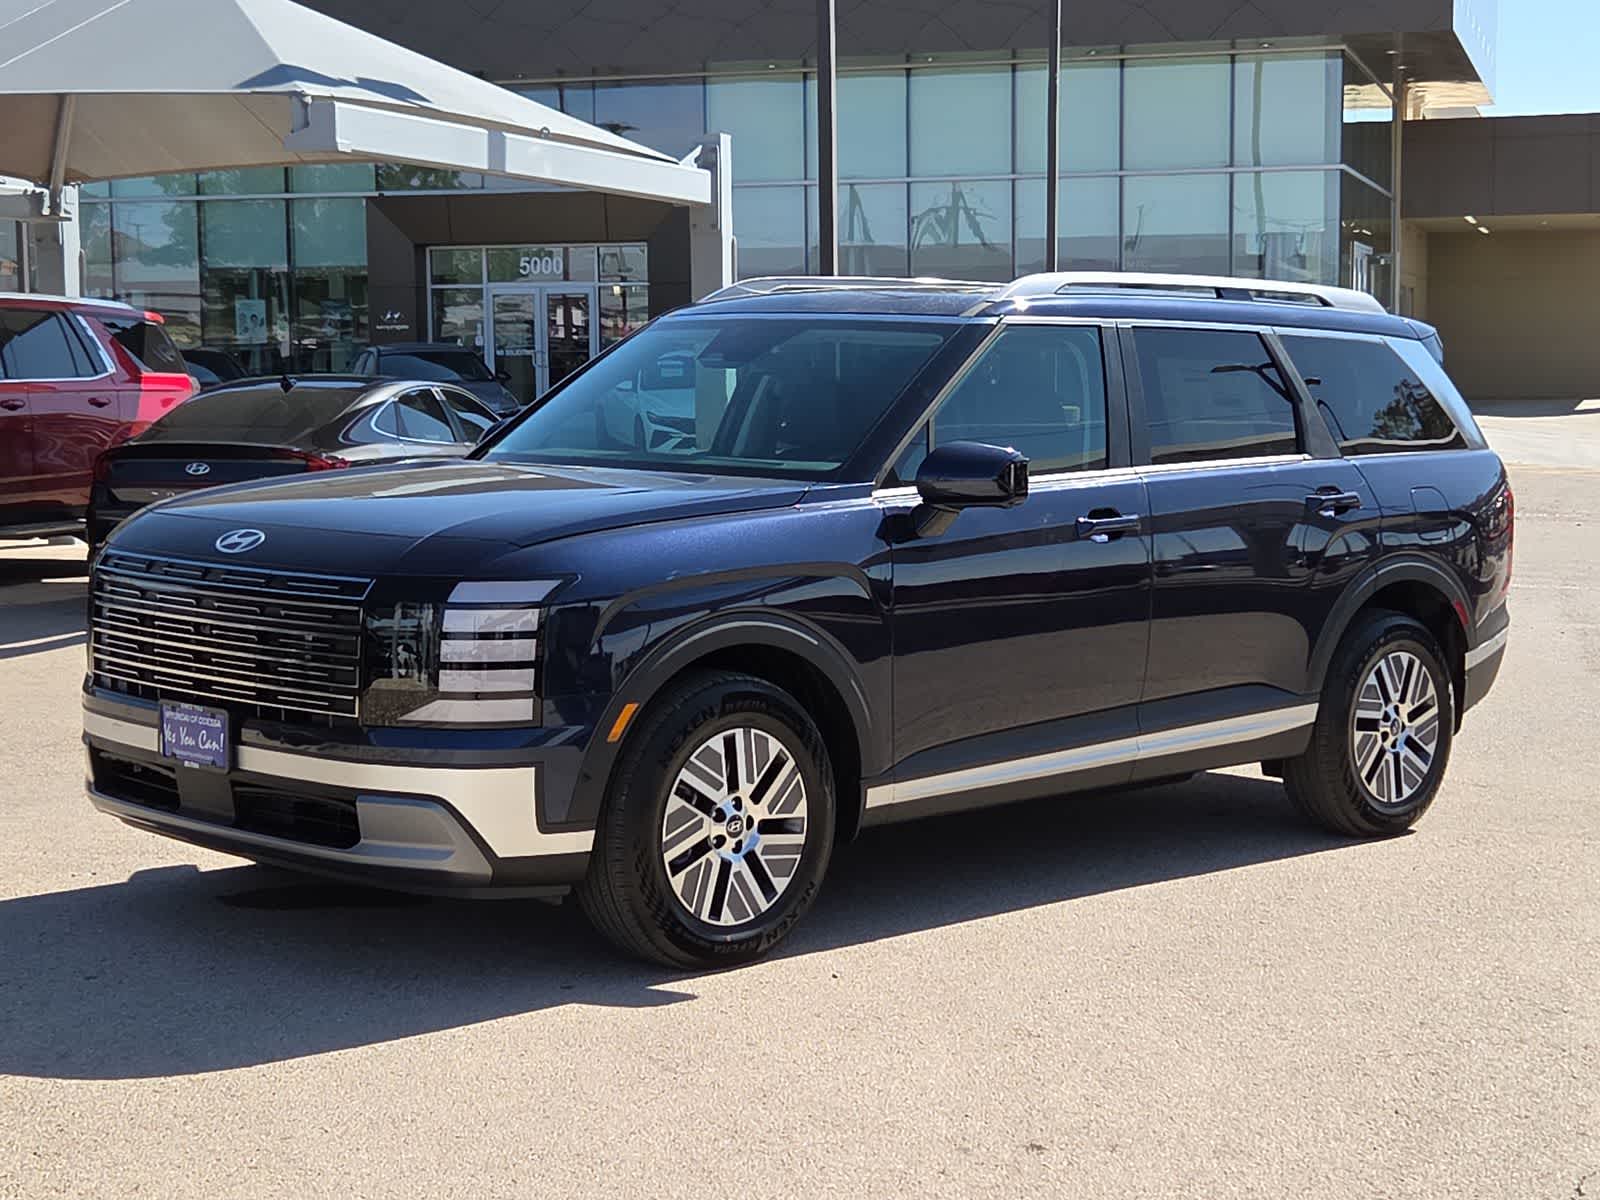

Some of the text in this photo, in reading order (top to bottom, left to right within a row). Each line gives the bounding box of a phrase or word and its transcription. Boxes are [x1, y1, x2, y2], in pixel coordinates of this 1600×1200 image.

[520, 256, 563, 275] 5000
[164, 723, 176, 743] Yes
[198, 730, 224, 753] Can!
